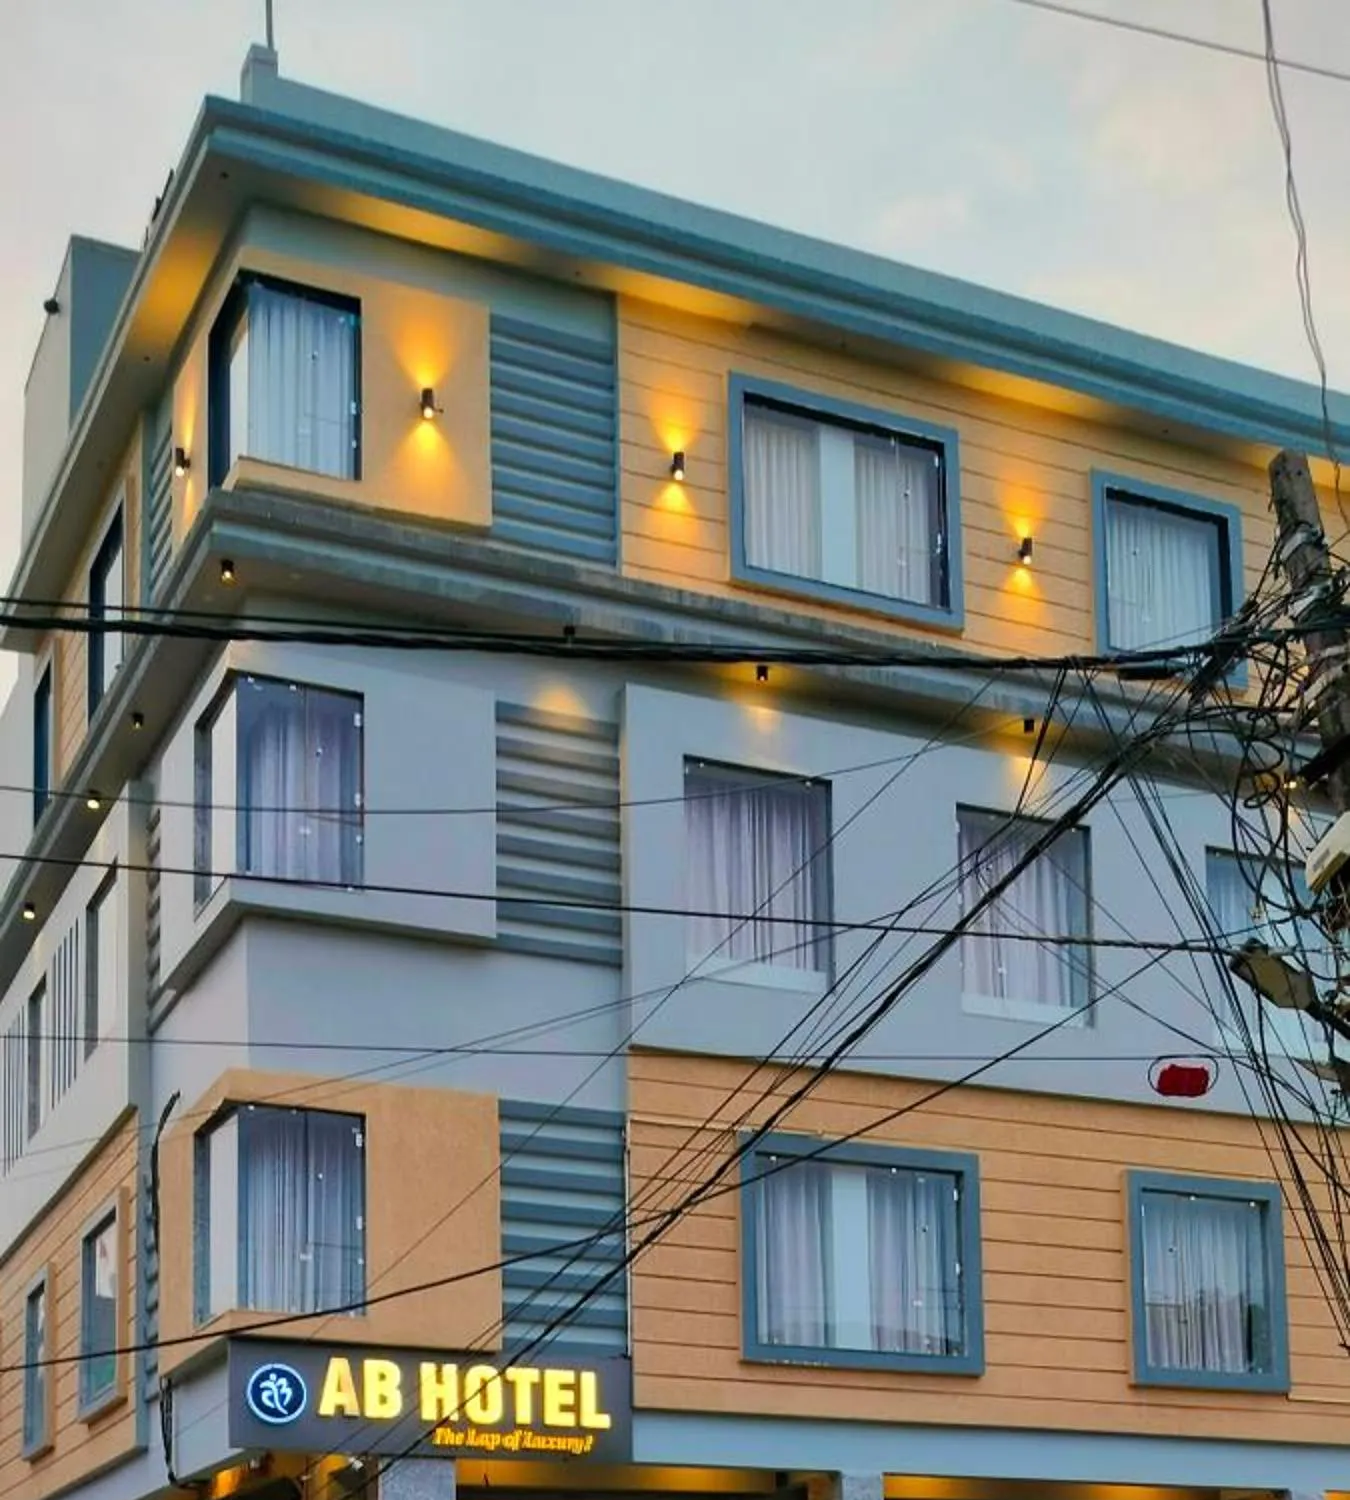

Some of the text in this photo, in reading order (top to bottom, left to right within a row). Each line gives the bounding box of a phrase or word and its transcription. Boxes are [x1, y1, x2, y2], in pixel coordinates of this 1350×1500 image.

[318, 1357, 402, 1420] AB
[418, 1361, 612, 1430] HOTEL
[432, 1427, 464, 1446] The
[465, 1428, 501, 1451] Lap
[501, 1430, 522, 1452] of
